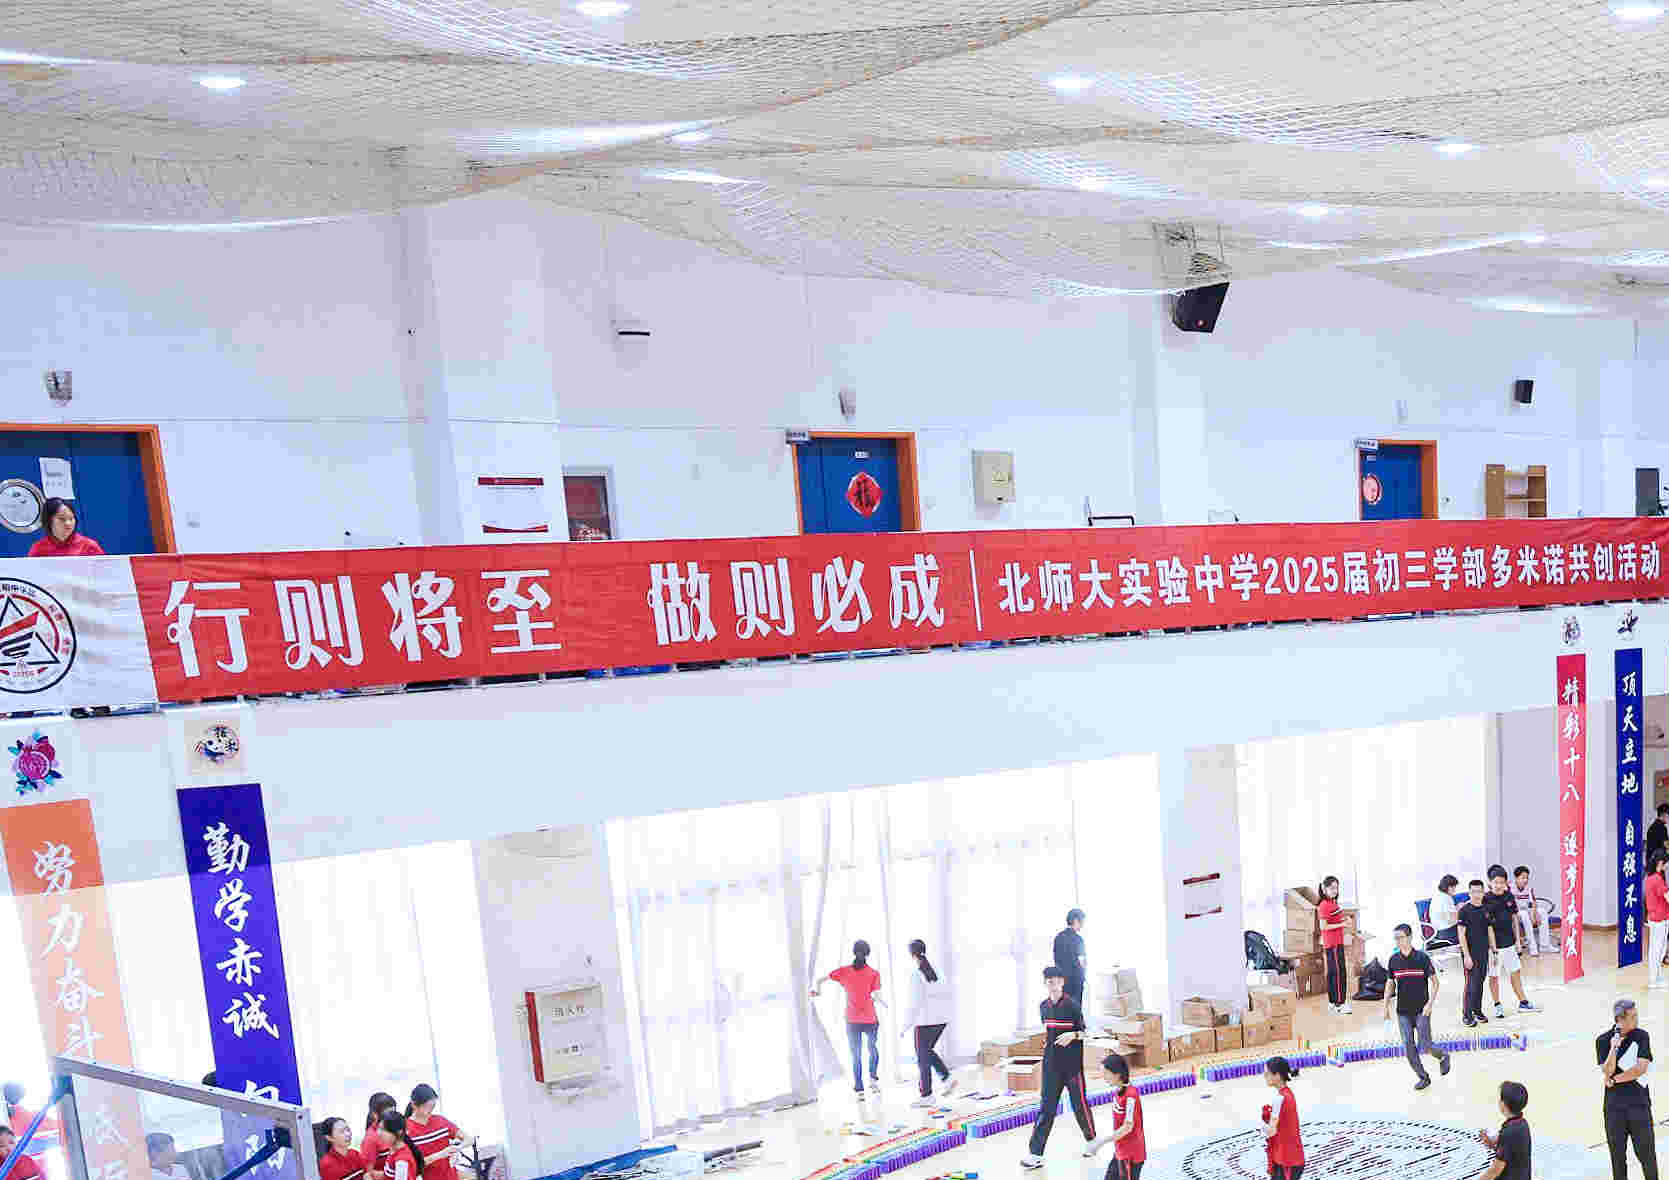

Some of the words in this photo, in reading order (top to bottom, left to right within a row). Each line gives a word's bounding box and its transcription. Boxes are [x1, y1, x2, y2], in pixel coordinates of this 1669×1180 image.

[164, 568, 564, 679] 行则将至
[646, 553, 945, 646] 做则必成
[998, 541, 1663, 616] 北师大实验中学2025届初三学部多米诺共创活动
[1621, 671, 1639, 795] 顶天立地
[203, 822, 280, 1040] 勤学赤诚
[1622, 819, 1639, 945] 自强不息
[32, 840, 104, 1057] 努力奋斗
